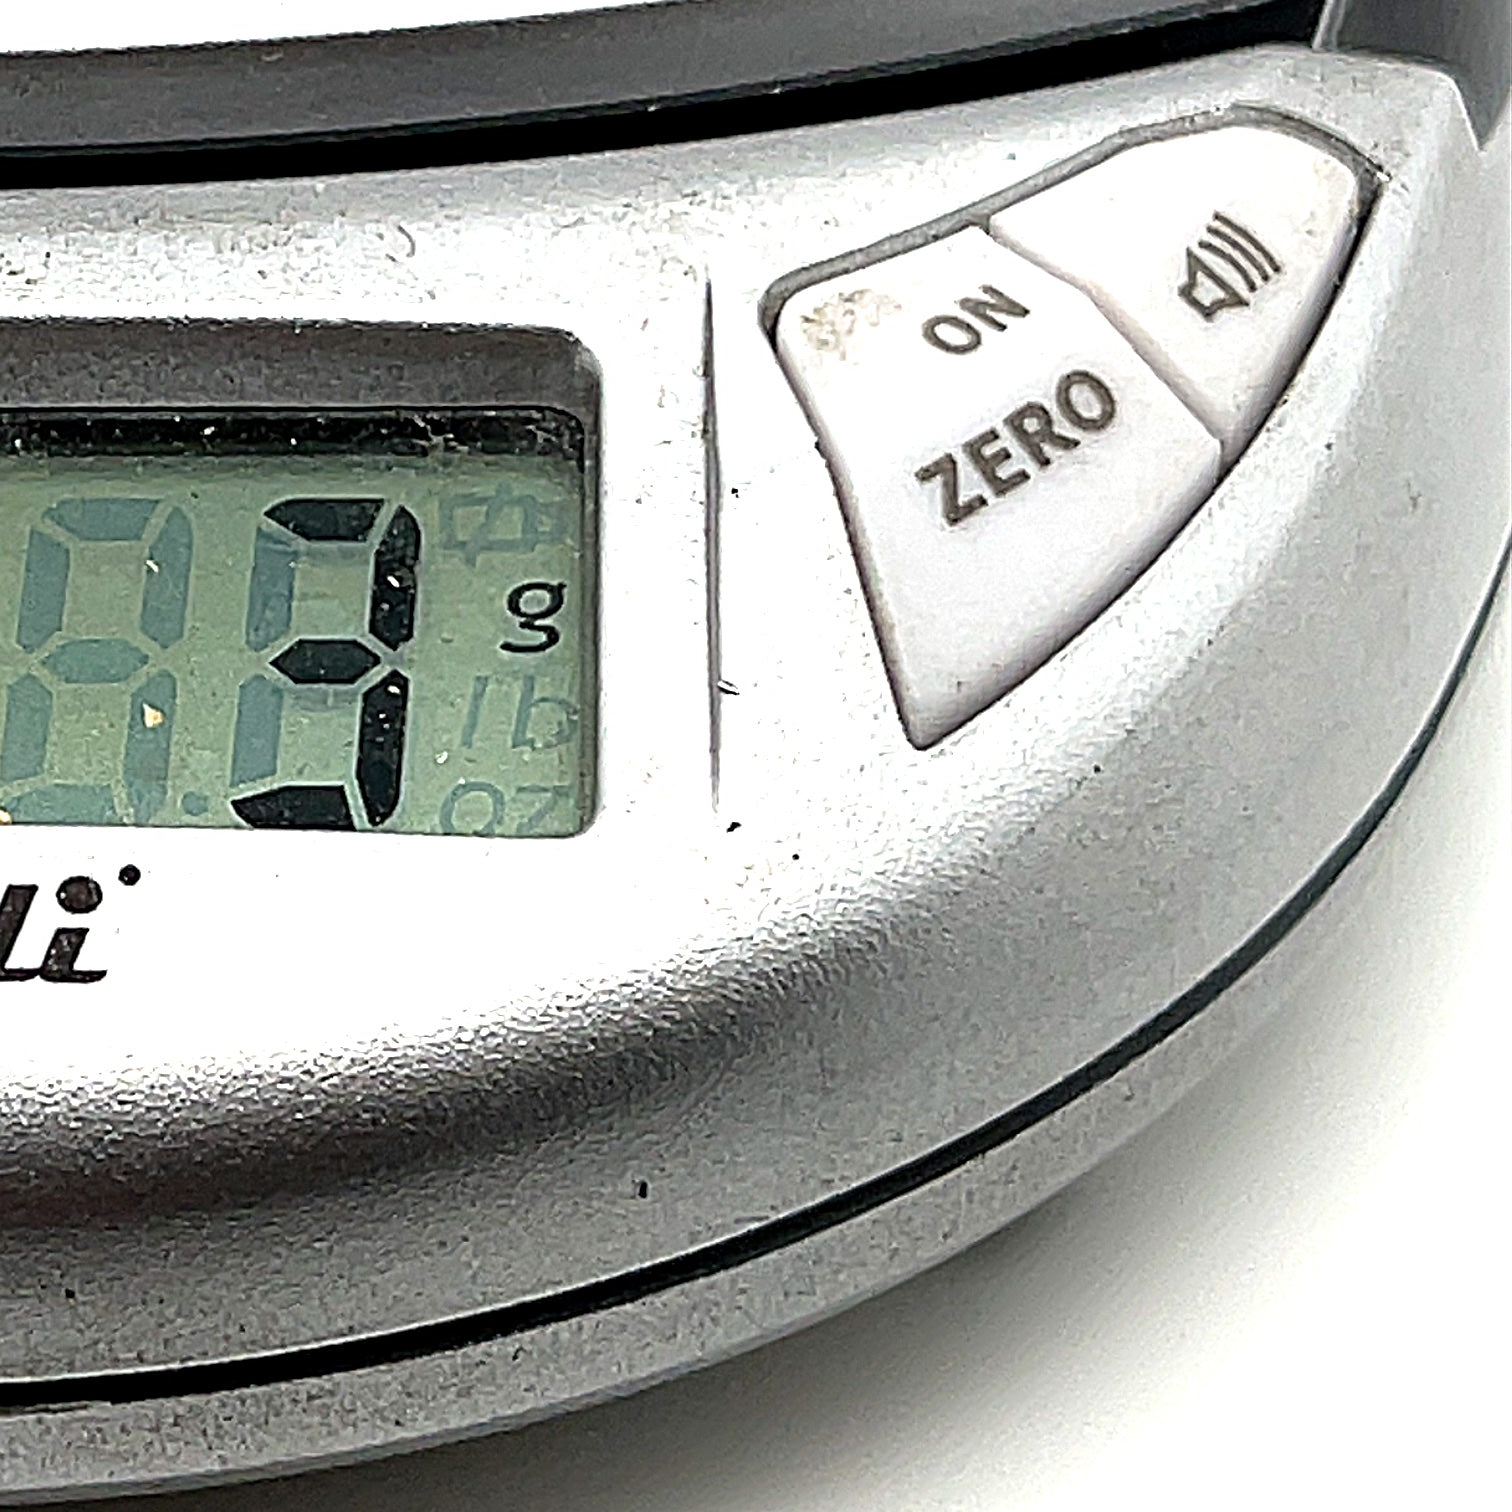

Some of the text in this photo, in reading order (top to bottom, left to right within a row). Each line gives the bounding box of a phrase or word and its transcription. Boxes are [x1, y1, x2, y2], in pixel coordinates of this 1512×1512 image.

[921, 284, 1030, 356] ON
[915, 369, 1118, 527] ZERO
[499, 581, 567, 654] g
